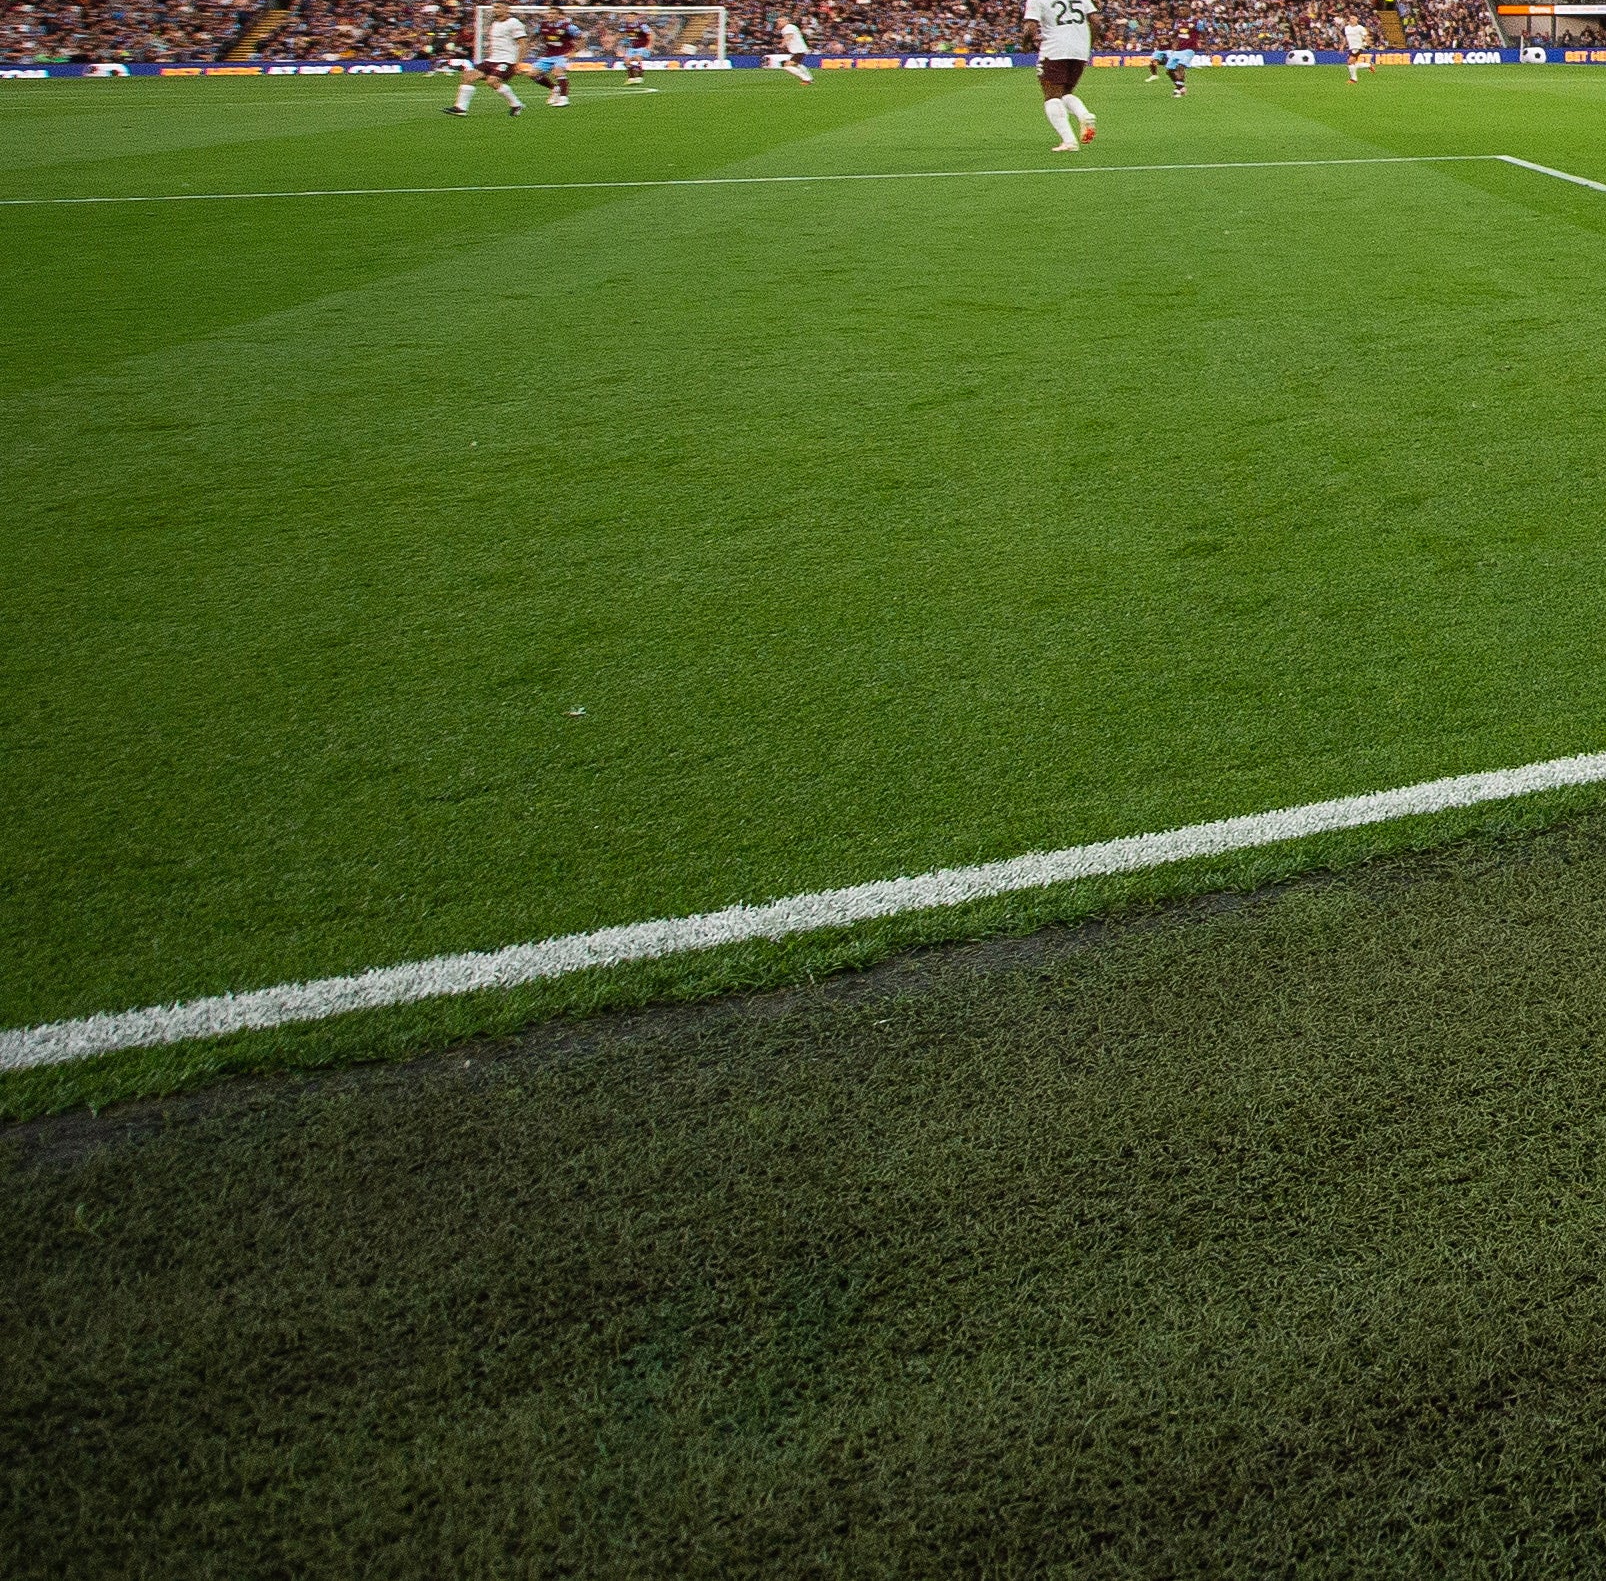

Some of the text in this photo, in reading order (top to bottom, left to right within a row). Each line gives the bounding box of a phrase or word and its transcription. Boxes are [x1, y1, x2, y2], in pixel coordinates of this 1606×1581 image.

[1051, 0, 1085, 26] 25
[904, 57, 929, 68] AT
[1092, 56, 1121, 67] BET
[1374, 53, 1411, 65] HERE
[1413, 52, 1433, 64] AT
[1434, 52, 1500, 64] BK8.COM
